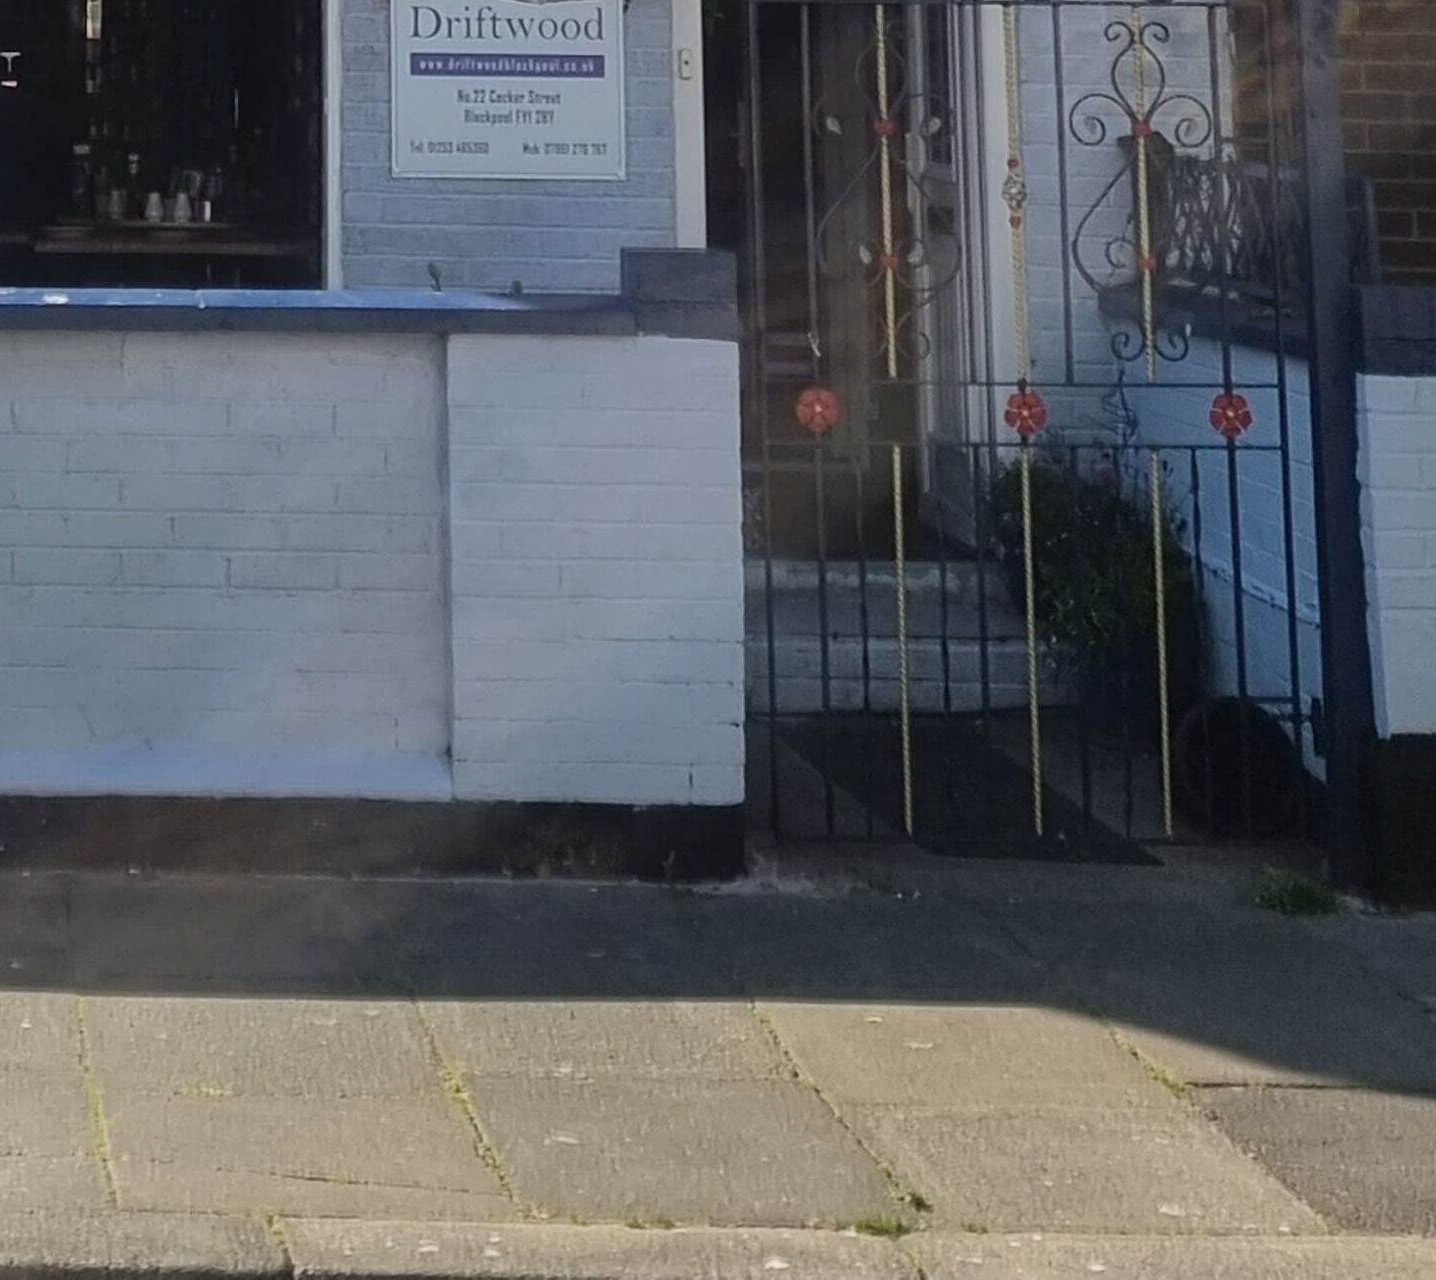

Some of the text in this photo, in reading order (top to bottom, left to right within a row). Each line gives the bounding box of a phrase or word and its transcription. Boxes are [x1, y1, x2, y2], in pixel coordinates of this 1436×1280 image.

[409, 4, 604, 41] Driftwood
[489, 89, 525, 104] Cocker
[528, 89, 561, 105] Street
[463, 108, 513, 126] Blackpool
